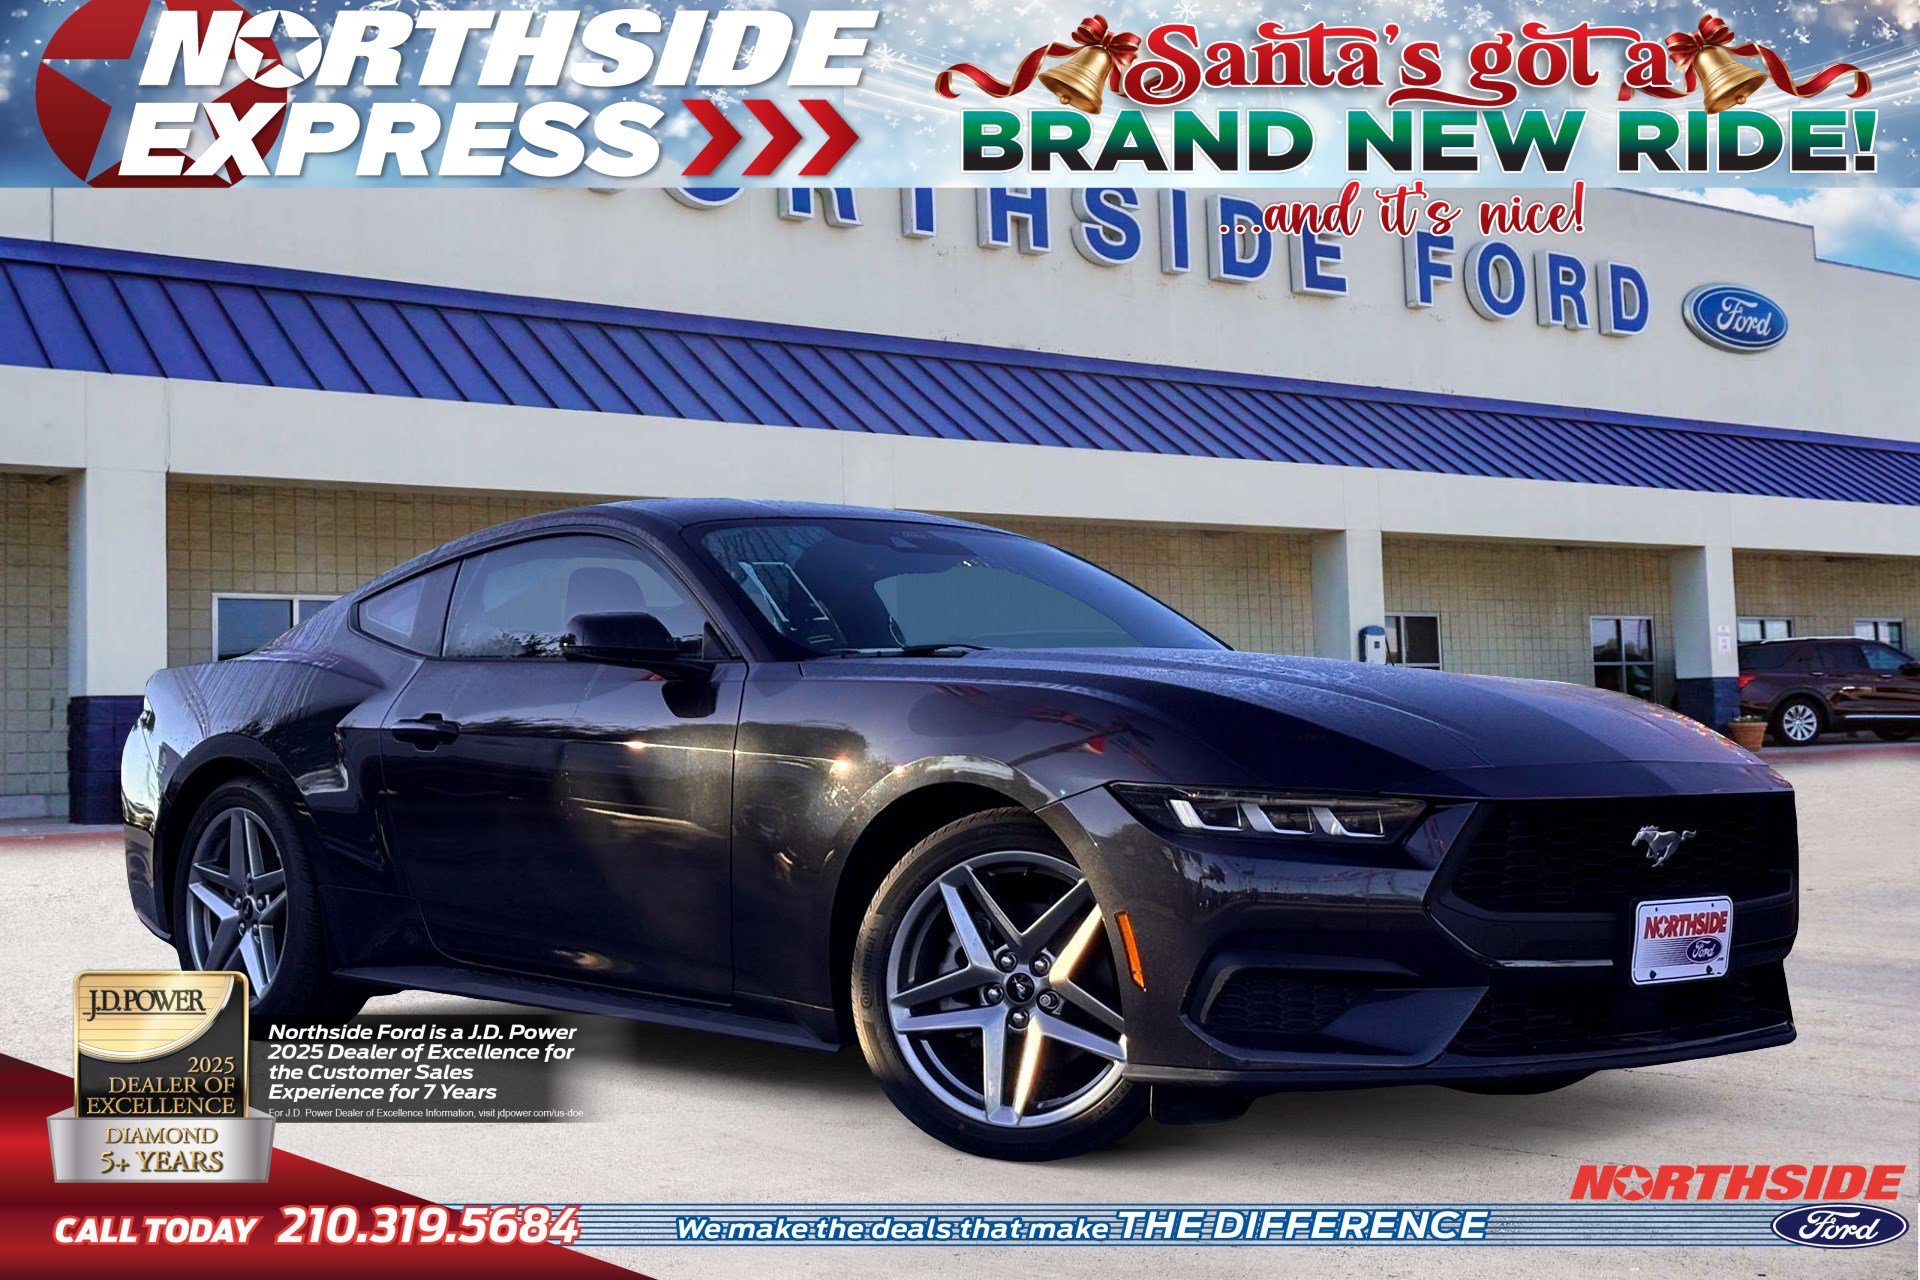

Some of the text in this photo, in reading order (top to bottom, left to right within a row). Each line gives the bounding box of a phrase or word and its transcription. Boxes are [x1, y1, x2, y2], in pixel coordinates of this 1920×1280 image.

[1403, 229, 1650, 338] FORD
[1715, 295, 1774, 338] Ford
[1644, 911, 1728, 939] NORTHSIDE
[1692, 940, 1716, 958] Ford
